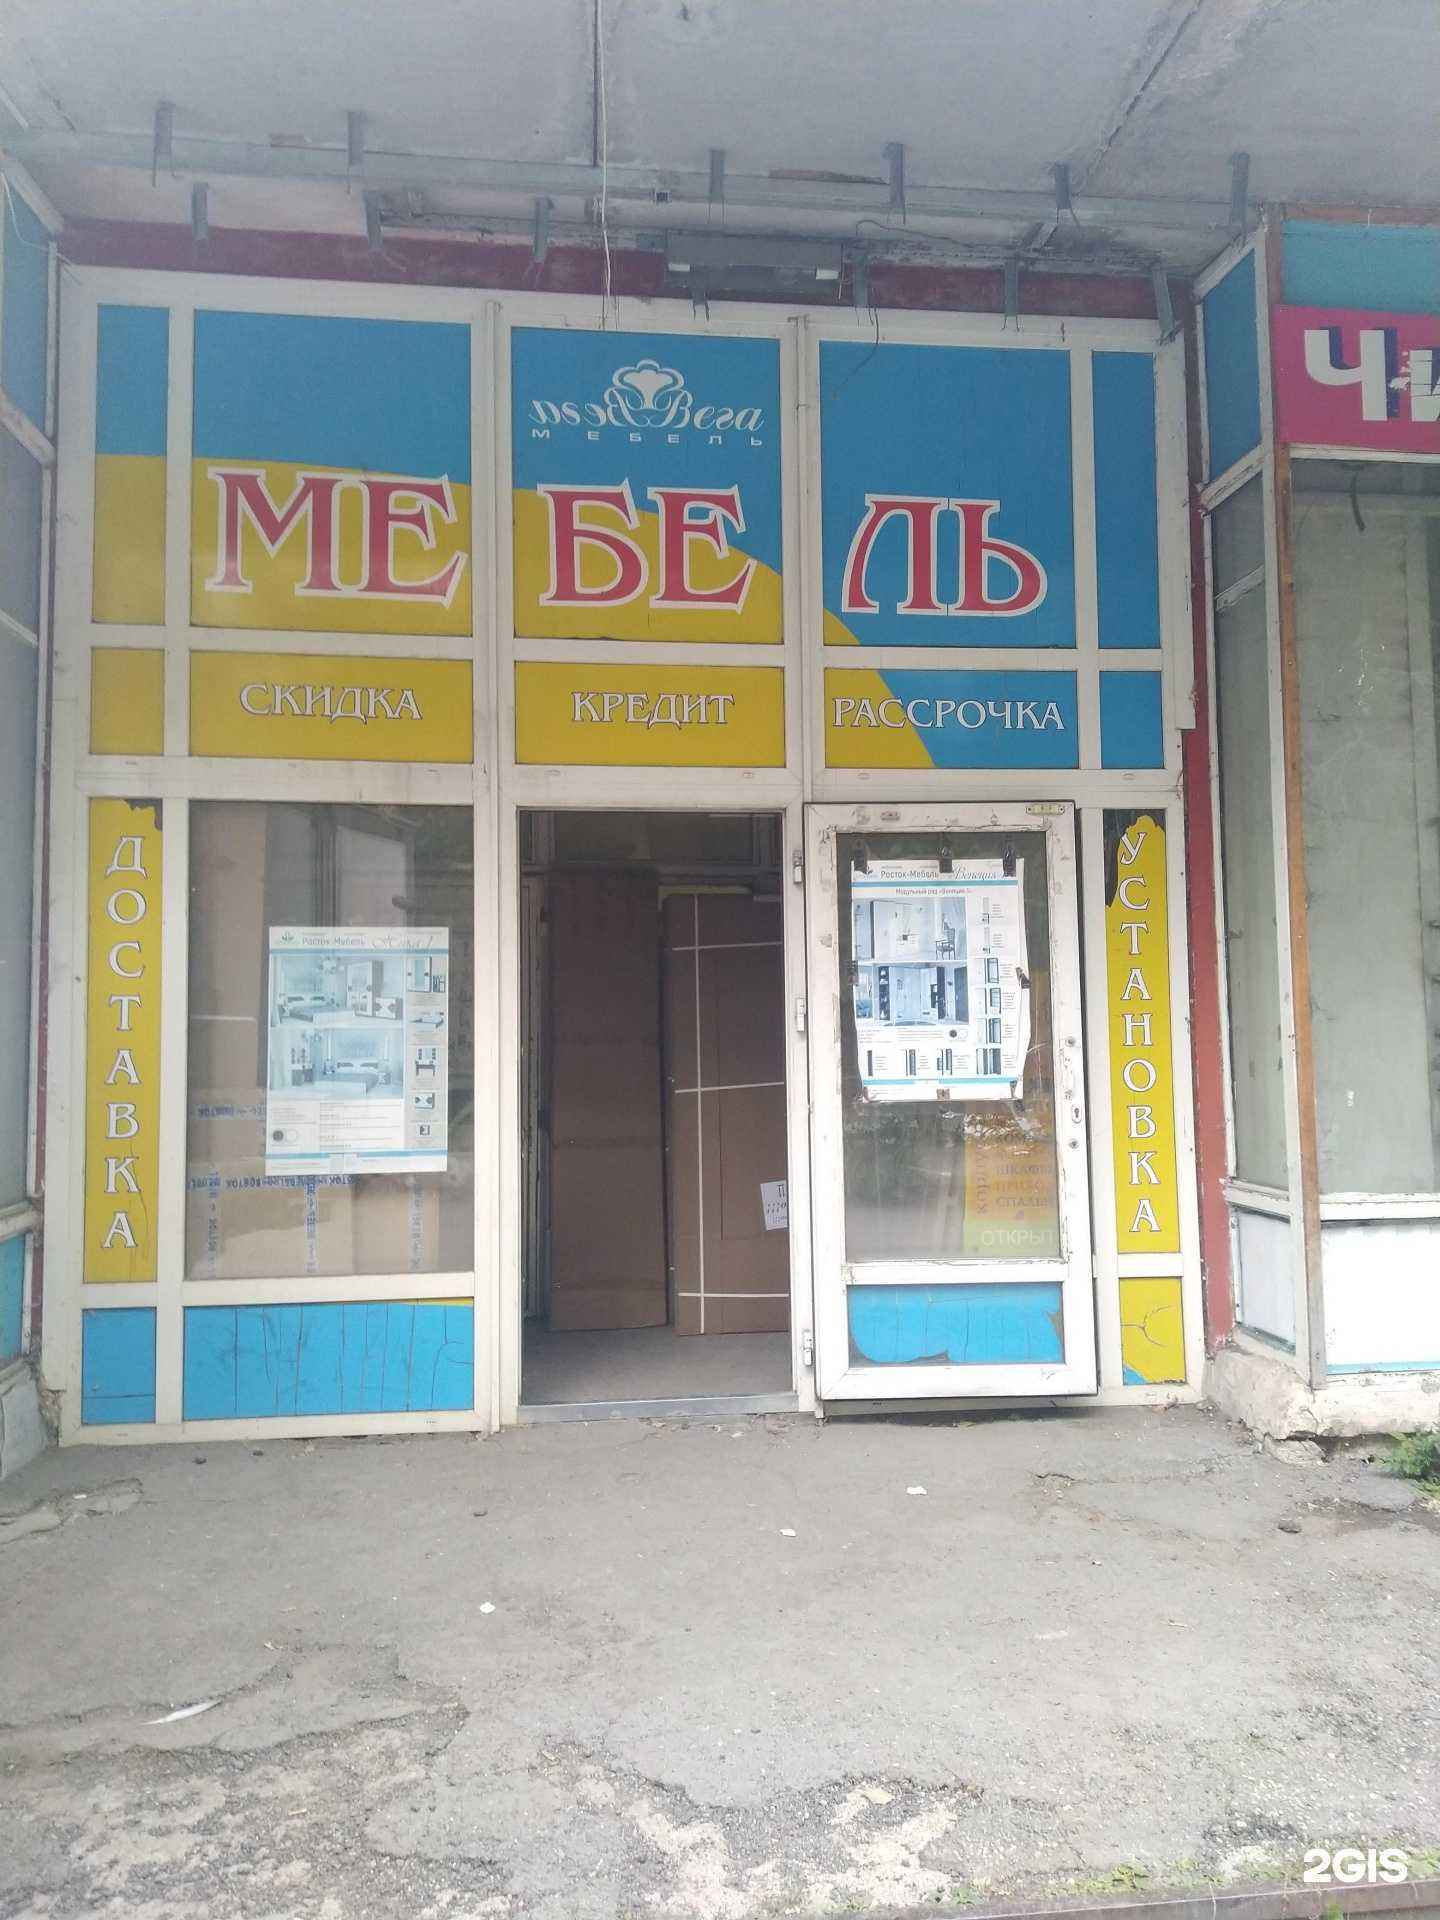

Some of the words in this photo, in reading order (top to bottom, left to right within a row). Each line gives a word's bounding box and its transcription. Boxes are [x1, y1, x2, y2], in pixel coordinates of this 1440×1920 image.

[531, 428, 763, 446] МЕБЕЛЬ
[239, 682, 423, 724] СКИДКА
[571, 690, 735, 729] КРЕДИТ
[832, 695, 1066, 732] РАССРОЧКА
[103, 835, 148, 1249] ДОСТАВКА
[1119, 831, 1161, 1234] УСТАНОВКА
